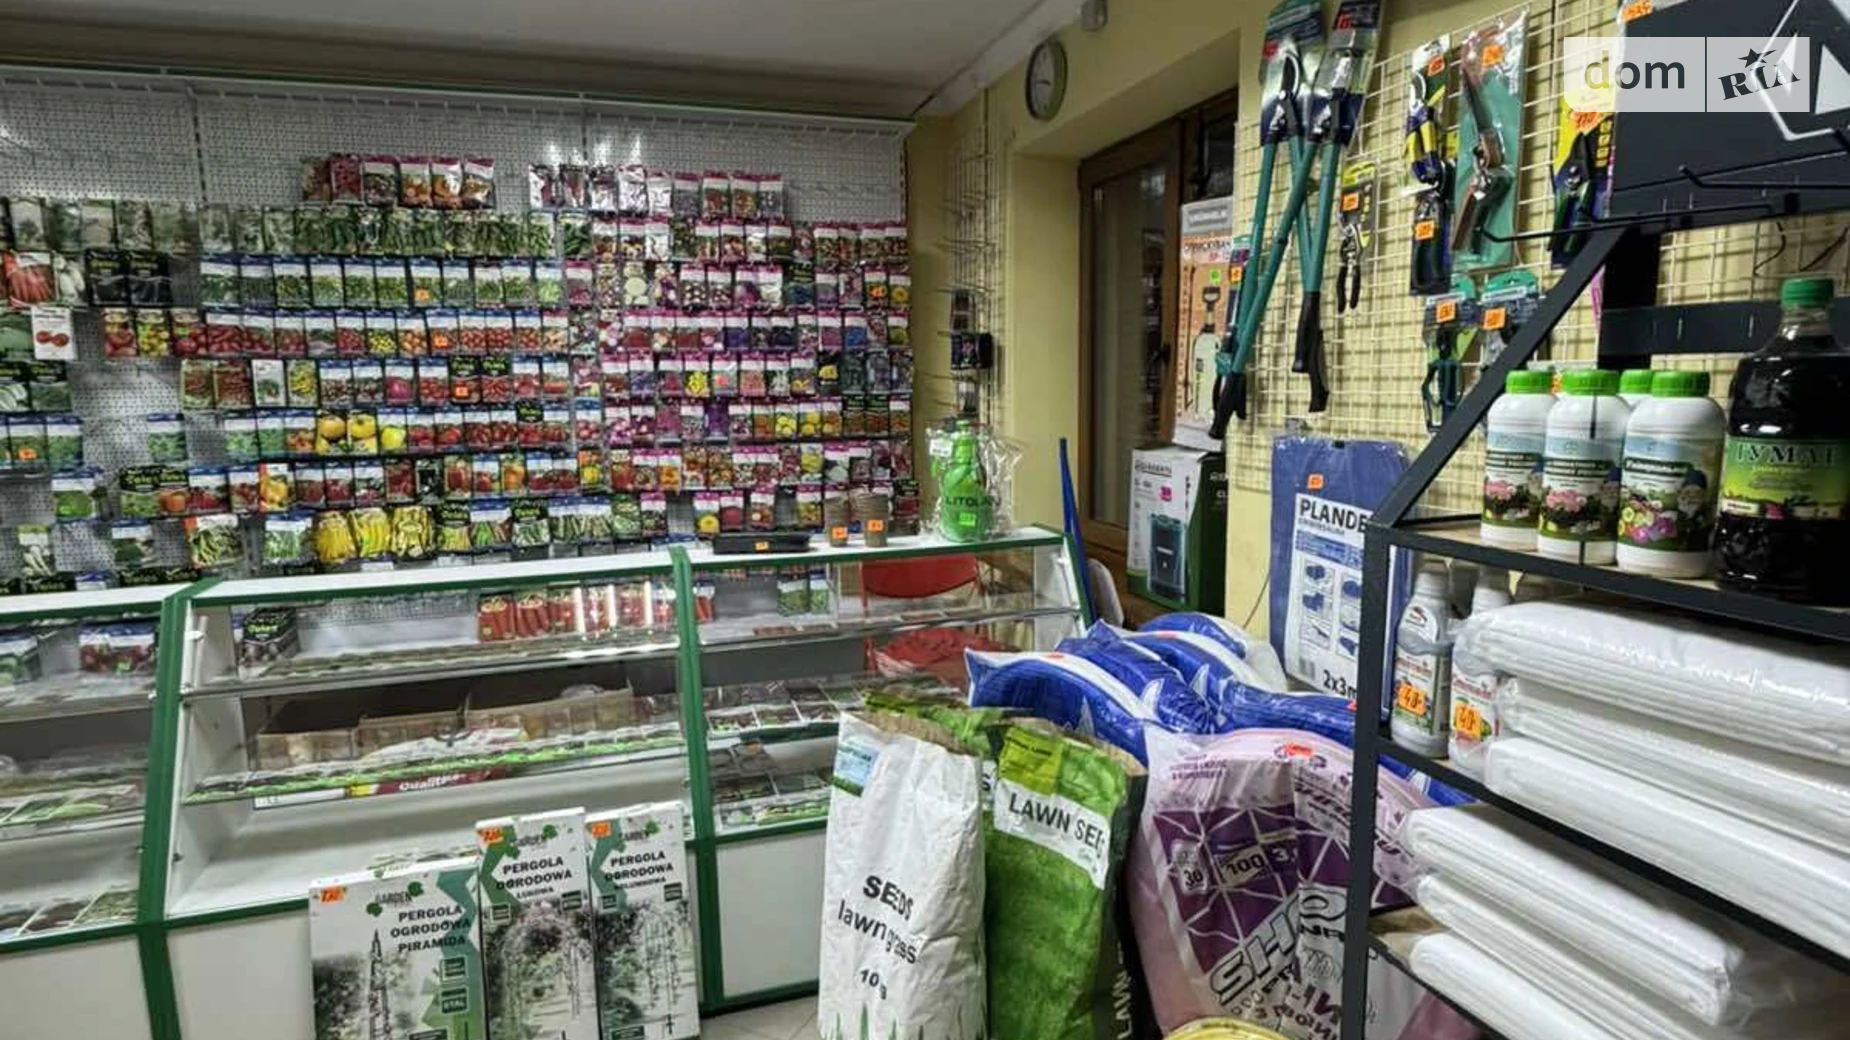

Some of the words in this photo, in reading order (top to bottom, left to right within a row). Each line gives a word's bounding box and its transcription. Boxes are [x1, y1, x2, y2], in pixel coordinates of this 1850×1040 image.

[1009, 792, 1071, 833] LAWN
[503, 856, 564, 875] PERGOLA
[610, 850, 666, 867] PERGOLA
[1227, 855, 1265, 876] 100
[496, 869, 573, 890] OGRODOWA
[604, 862, 674, 881] OGRODOWA
[398, 906, 463, 923] PERGOLA
[838, 900, 887, 940] lawn
[390, 918, 471, 938] OGRODOWA
[398, 935, 466, 953] PIRAMIDA
